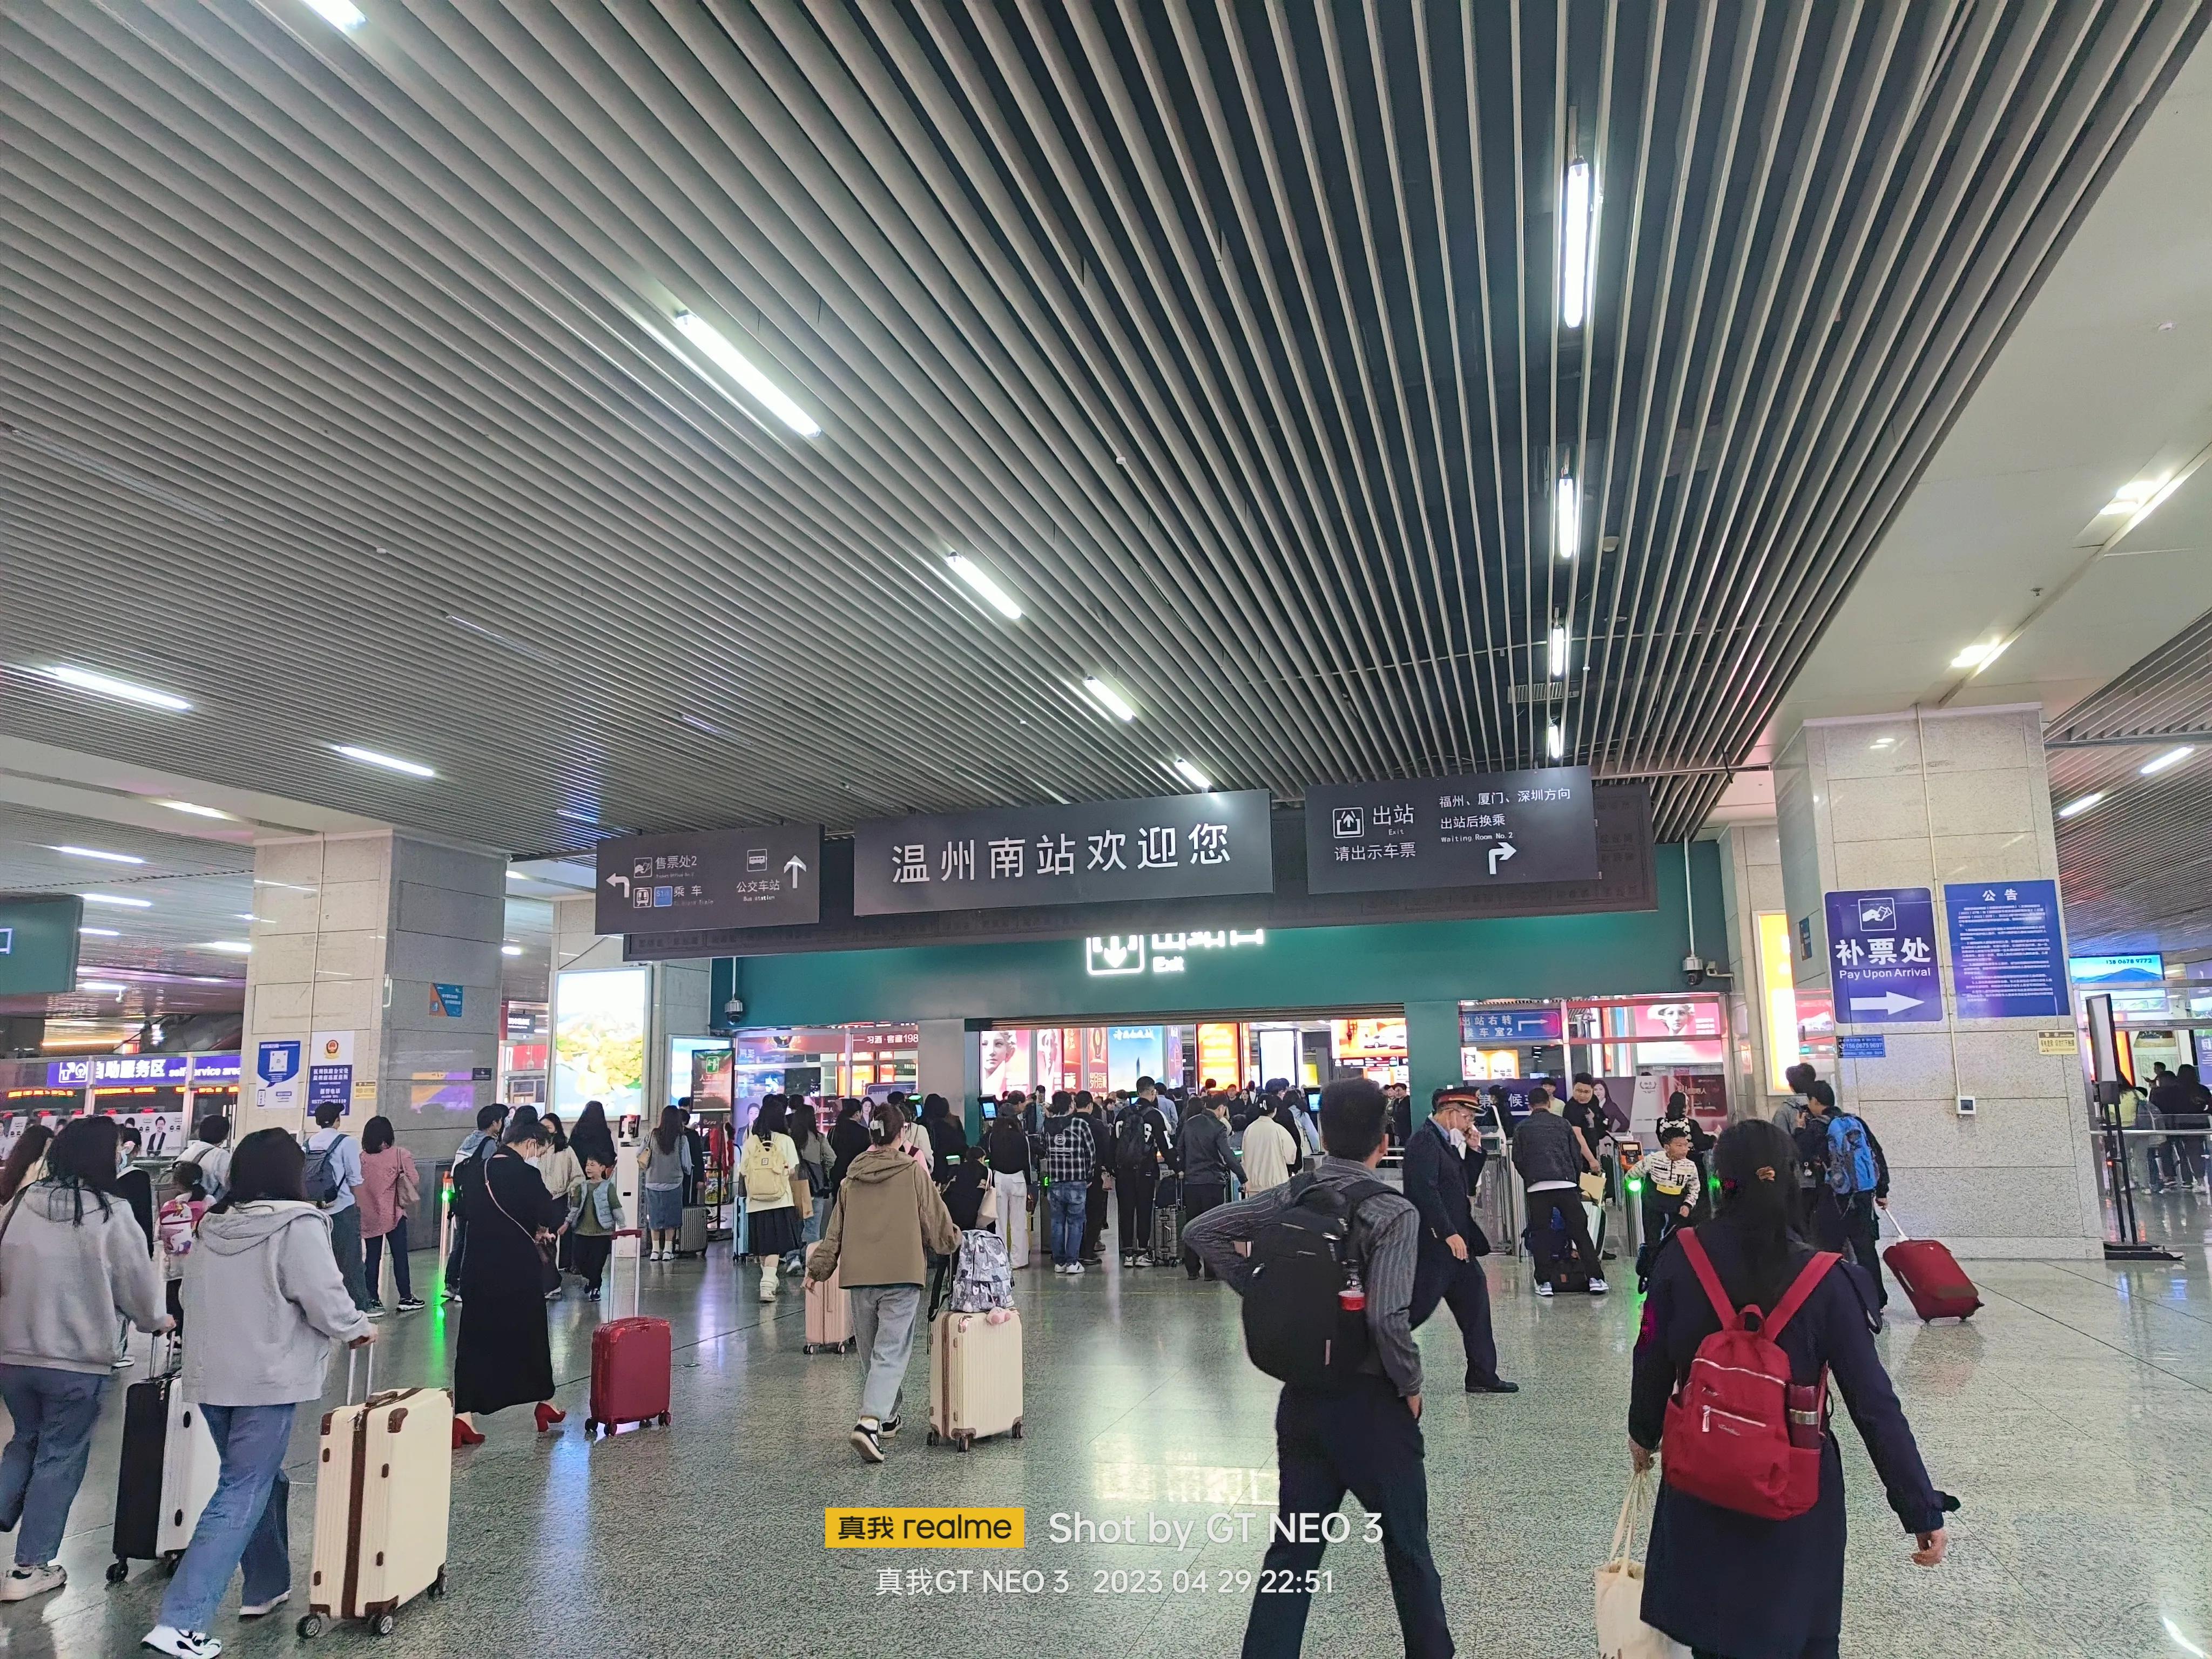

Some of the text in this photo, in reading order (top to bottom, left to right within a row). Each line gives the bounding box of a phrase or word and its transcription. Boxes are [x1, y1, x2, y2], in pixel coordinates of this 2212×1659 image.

[1439, 787, 1571, 808] 福州、厦门、深圳方向
[1373, 804, 1414, 826] 出站
[1440, 813, 1506, 830] 出站后换乘
[891, 822, 1232, 884] 温州南站欢迎您
[1334, 841, 1416, 862] 请出示车票
[655, 855, 697, 869] 售票处2
[736, 879, 780, 893] 公交车站
[1982, 888, 2018, 901] 公告
[1835, 937, 1931, 966] 补票处
[1839, 967, 1931, 981] Pay Upon Arrival
